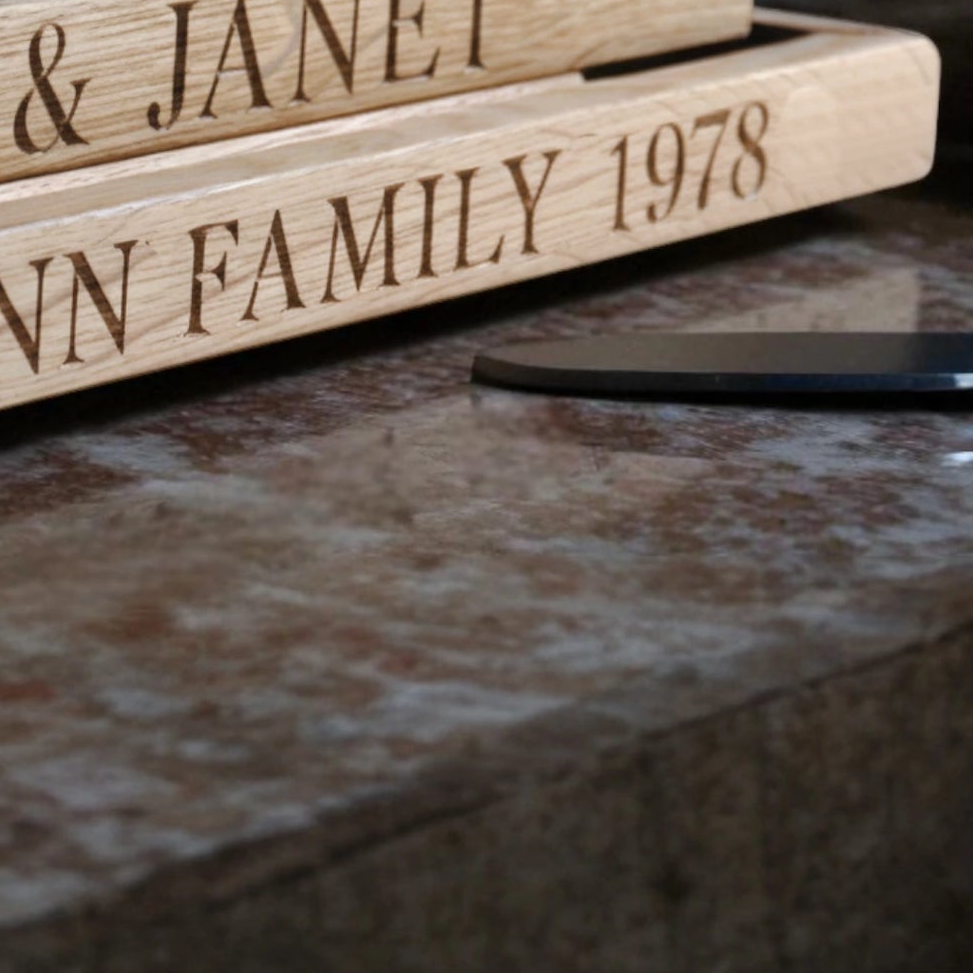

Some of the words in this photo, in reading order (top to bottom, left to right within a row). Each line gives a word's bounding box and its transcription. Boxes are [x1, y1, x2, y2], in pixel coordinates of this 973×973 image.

[13, 23, 92, 155] &
[183, 149, 563, 335] FAMILY
[608, 101, 770, 233] 1978
